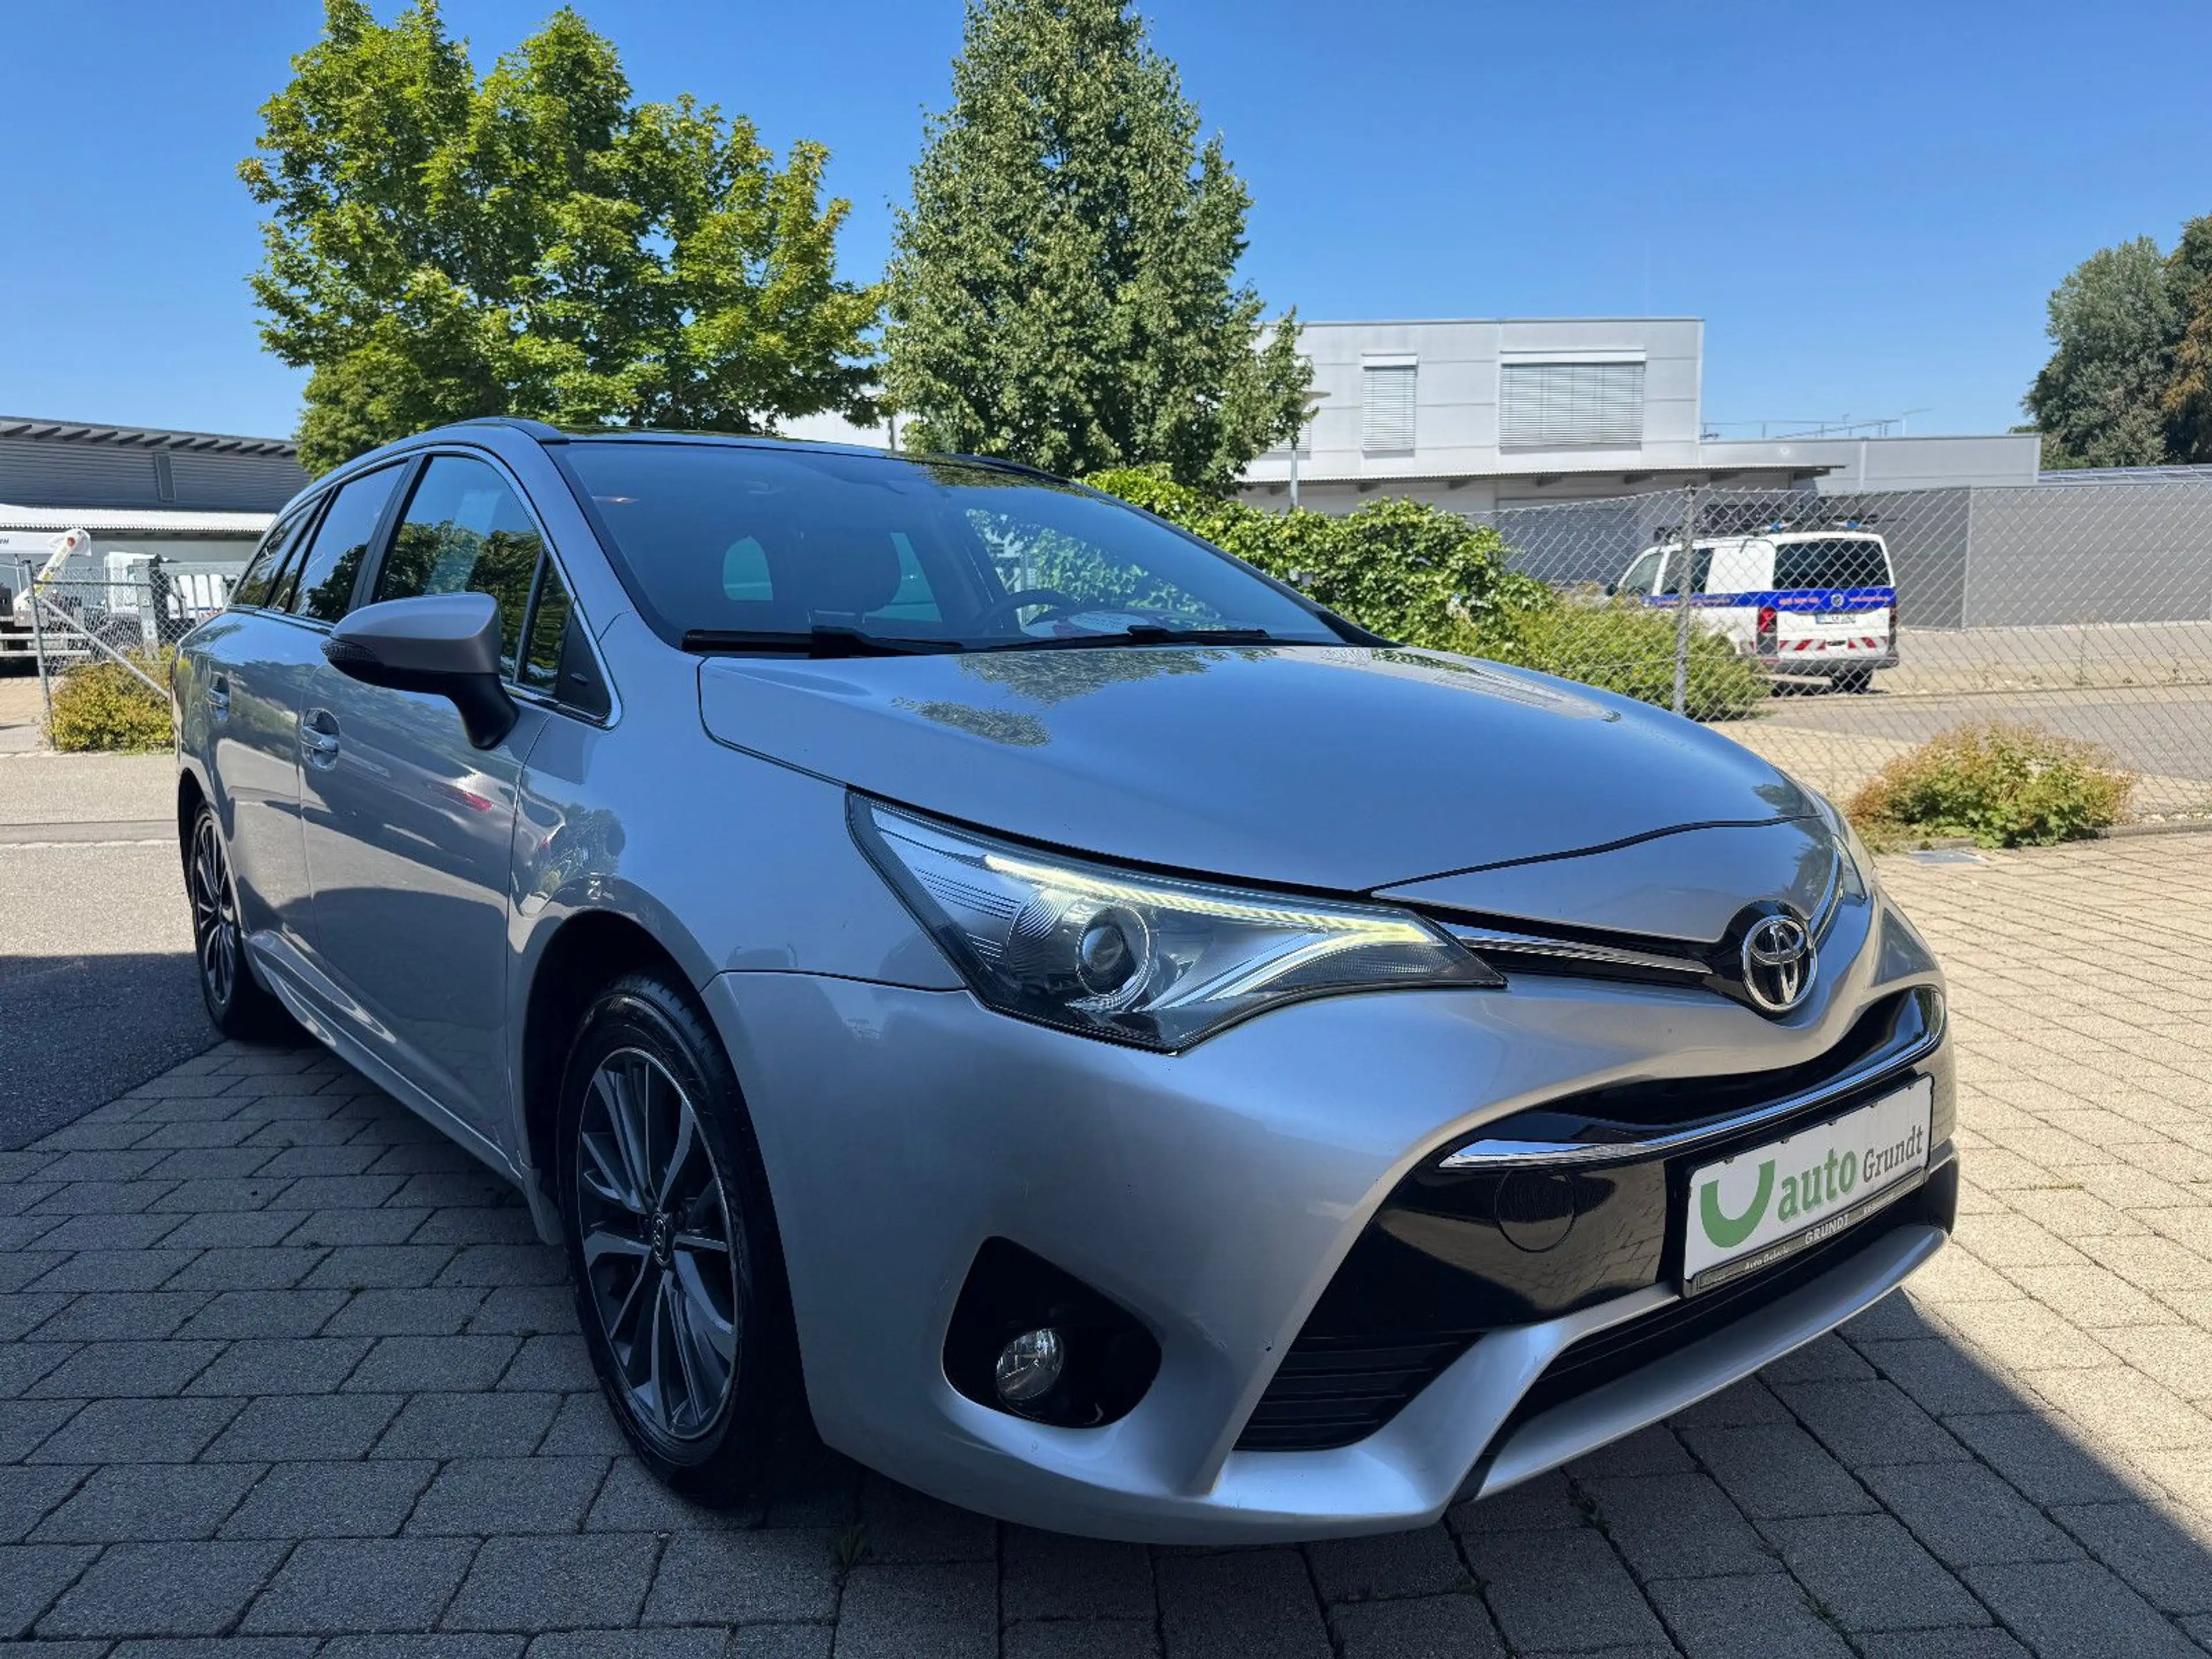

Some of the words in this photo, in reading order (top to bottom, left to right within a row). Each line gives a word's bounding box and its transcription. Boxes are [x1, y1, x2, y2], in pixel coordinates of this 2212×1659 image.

[1778, 1147, 1857, 1222] auto
[1863, 1125, 1923, 1183] Grundt
[1805, 1213, 1850, 1245] GRUNDT
